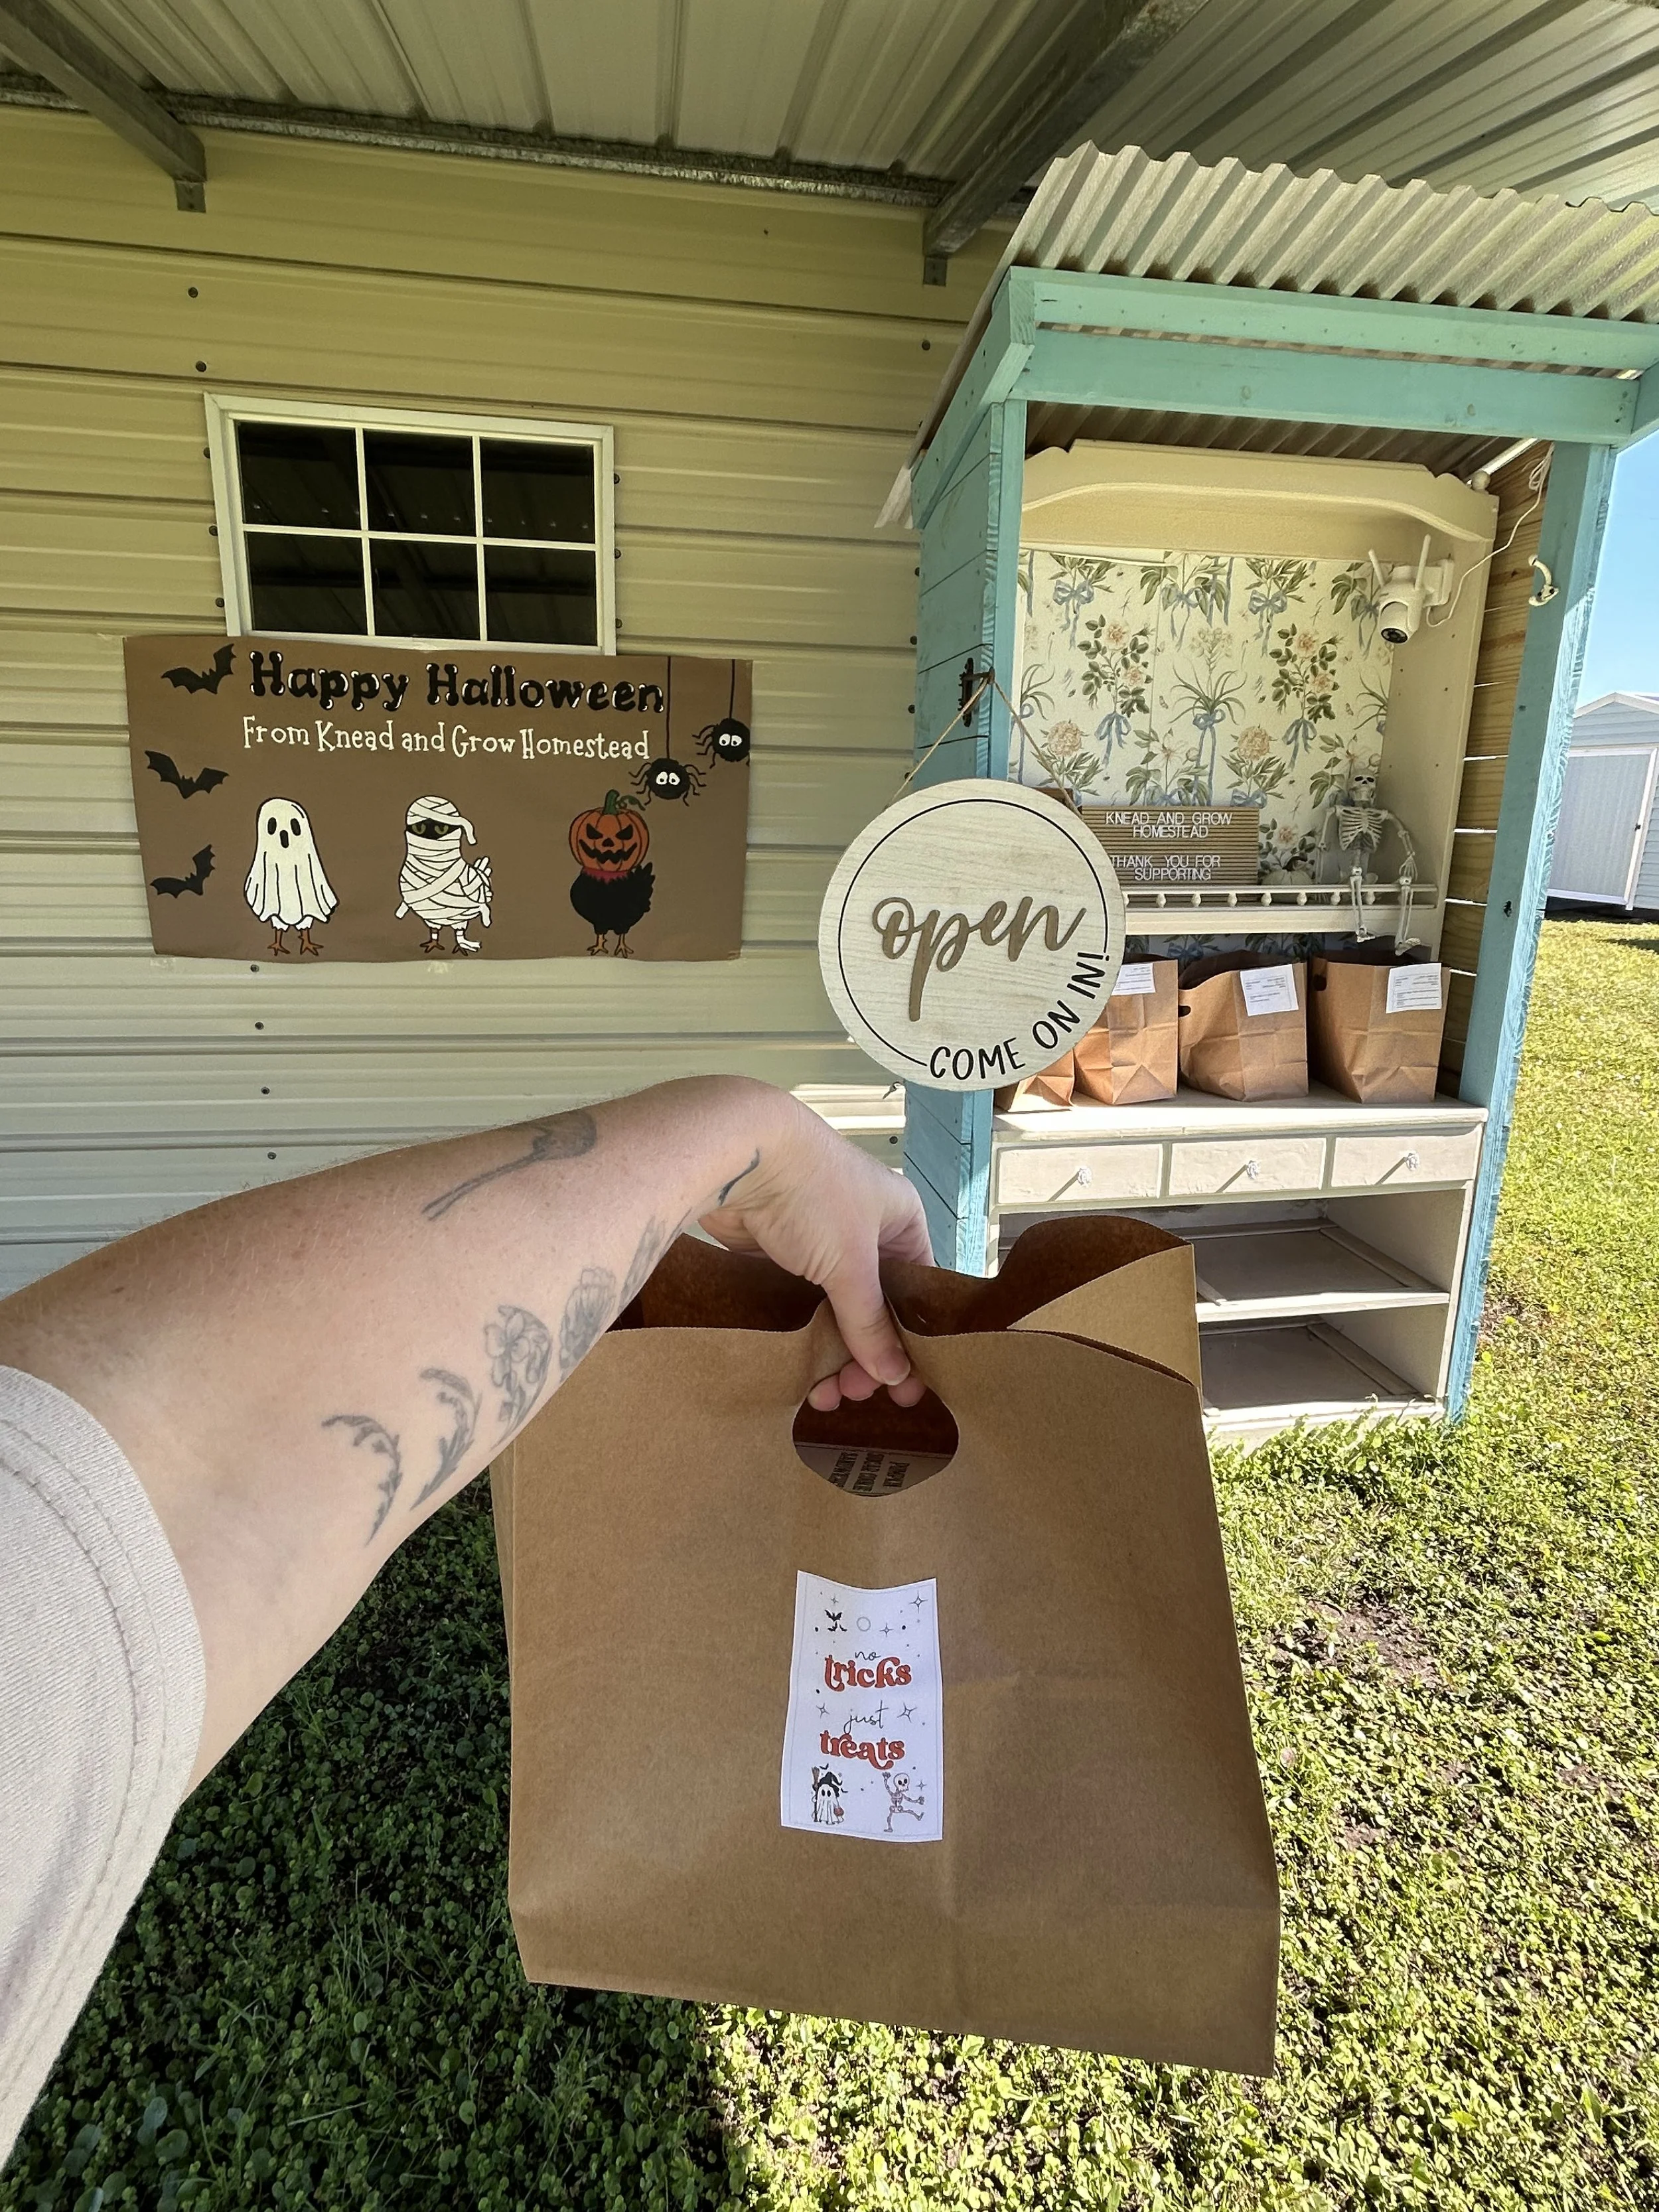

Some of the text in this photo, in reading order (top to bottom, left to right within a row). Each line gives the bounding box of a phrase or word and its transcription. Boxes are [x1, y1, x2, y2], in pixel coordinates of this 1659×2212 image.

[250, 650, 664, 713] Happy Halloween
[243, 715, 650, 760] From Knead and Grow Homestead
[1105, 812, 1232, 825] KNEAD AND GROW
[1133, 825, 1208, 838] HOMESTEAD
[1110, 855, 1221, 867] THANK YOU FOR
[1135, 868, 1211, 881] SUPPORTING
[872, 896, 1087, 1022] open
[930, 1037, 1025, 1080] COME
[1033, 999, 1080, 1049] ON
[1066, 951, 1110, 999] IN!
[855, 1650, 881, 1660] no
[824, 1655, 912, 1692] tricks
[843, 1700, 889, 1734] just
[820, 1730, 905, 1770] treats
